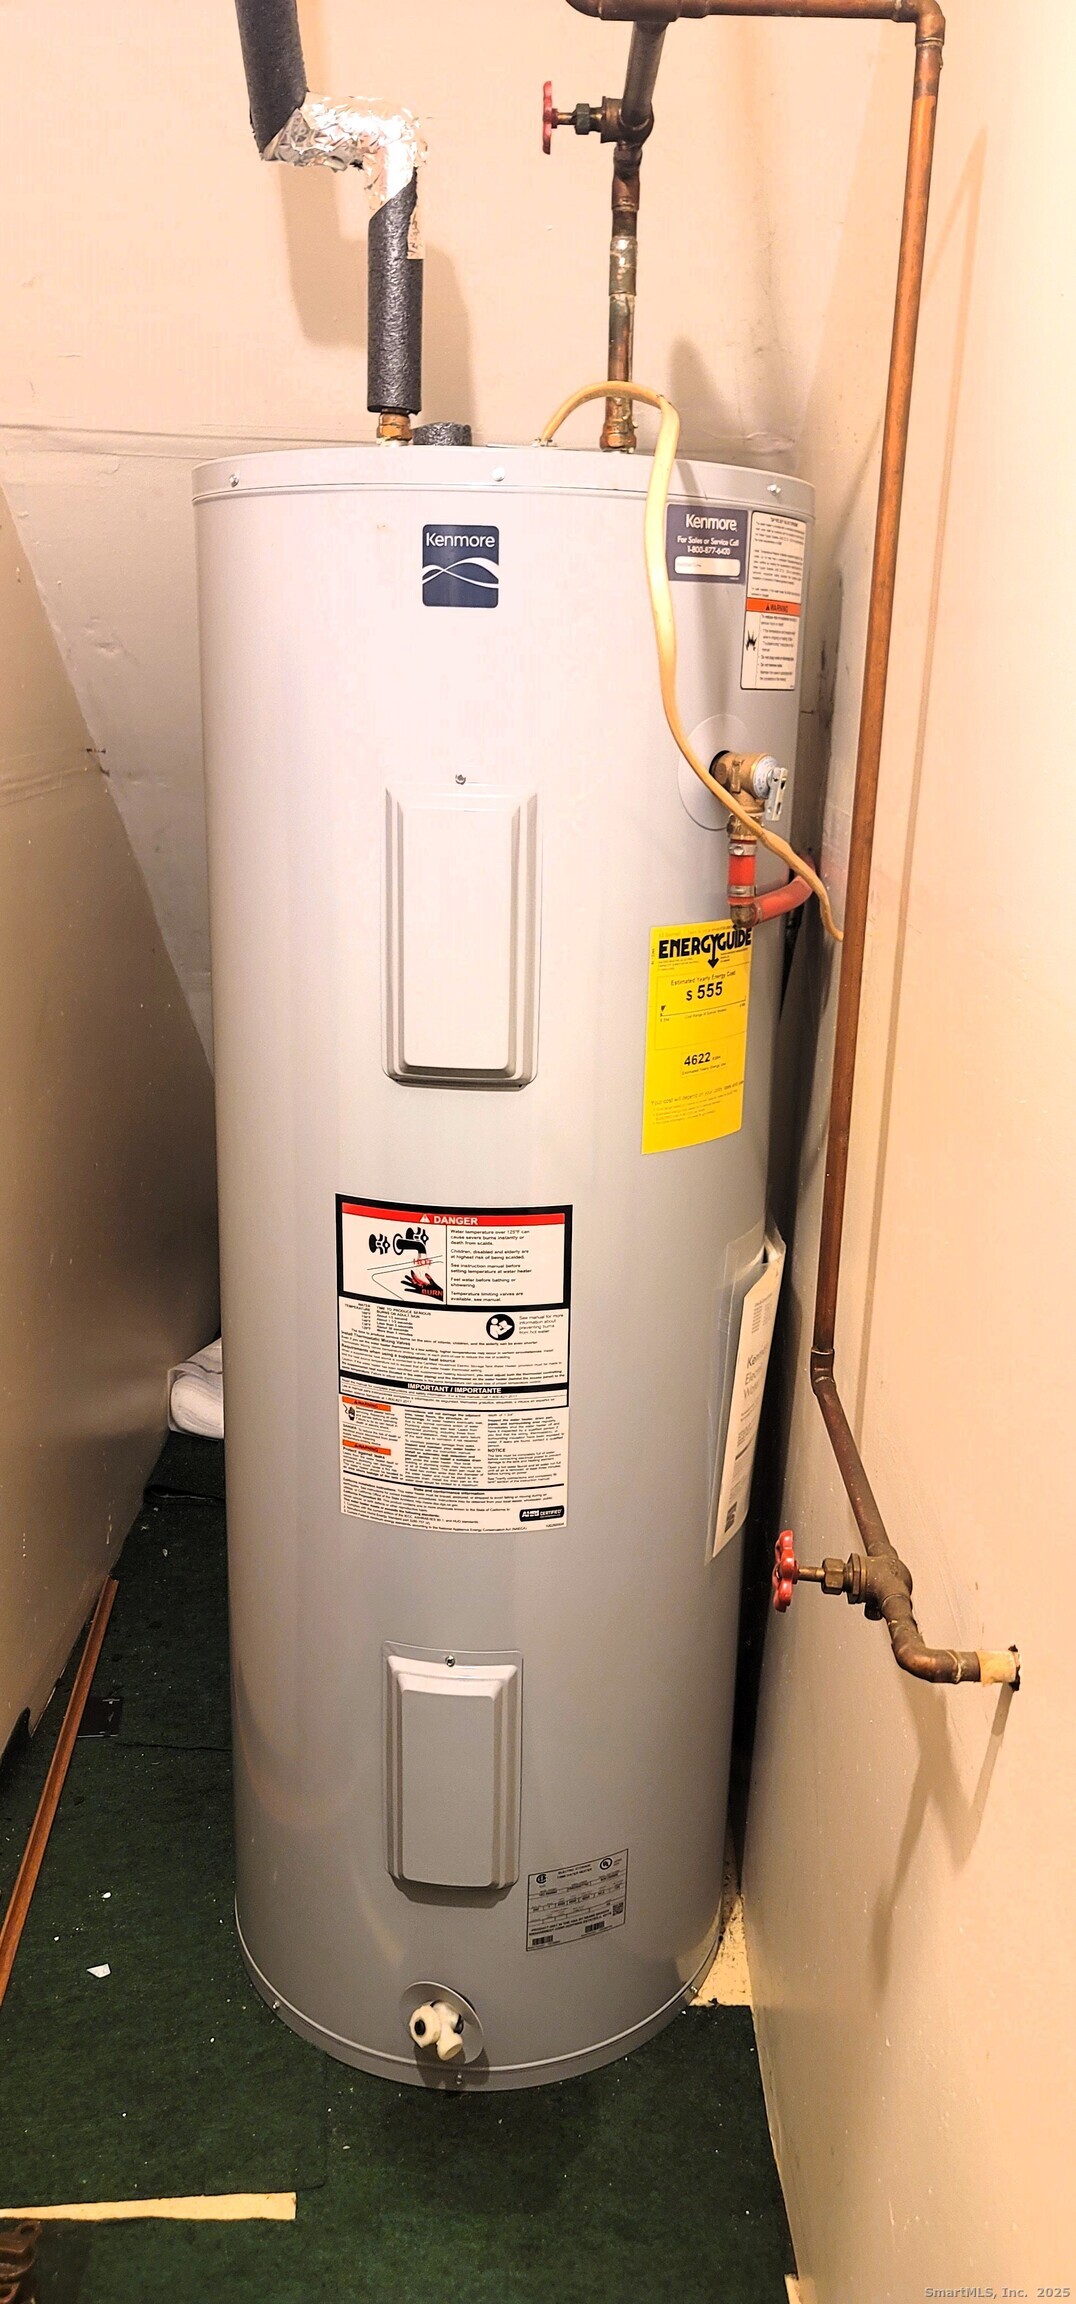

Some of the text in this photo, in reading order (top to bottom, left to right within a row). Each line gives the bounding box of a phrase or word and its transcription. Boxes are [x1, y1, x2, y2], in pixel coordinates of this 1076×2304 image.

[685, 513, 737, 531] Kenmore
[425, 532, 495, 548] Kenmore
[677, 535, 687, 543] For
[688, 535, 703, 545] Sales
[710, 537, 729, 546] Service
[729, 538, 740, 547] Call
[658, 928, 752, 960] ENERGYGUIDE
[686, 981, 723, 1002] $ 555
[683, 1051, 711, 1066] 4622
[433, 1215, 479, 1225] DANGER
[421, 1288, 443, 1296] BURN
[407, 1382, 449, 1392] IMPORTANT
